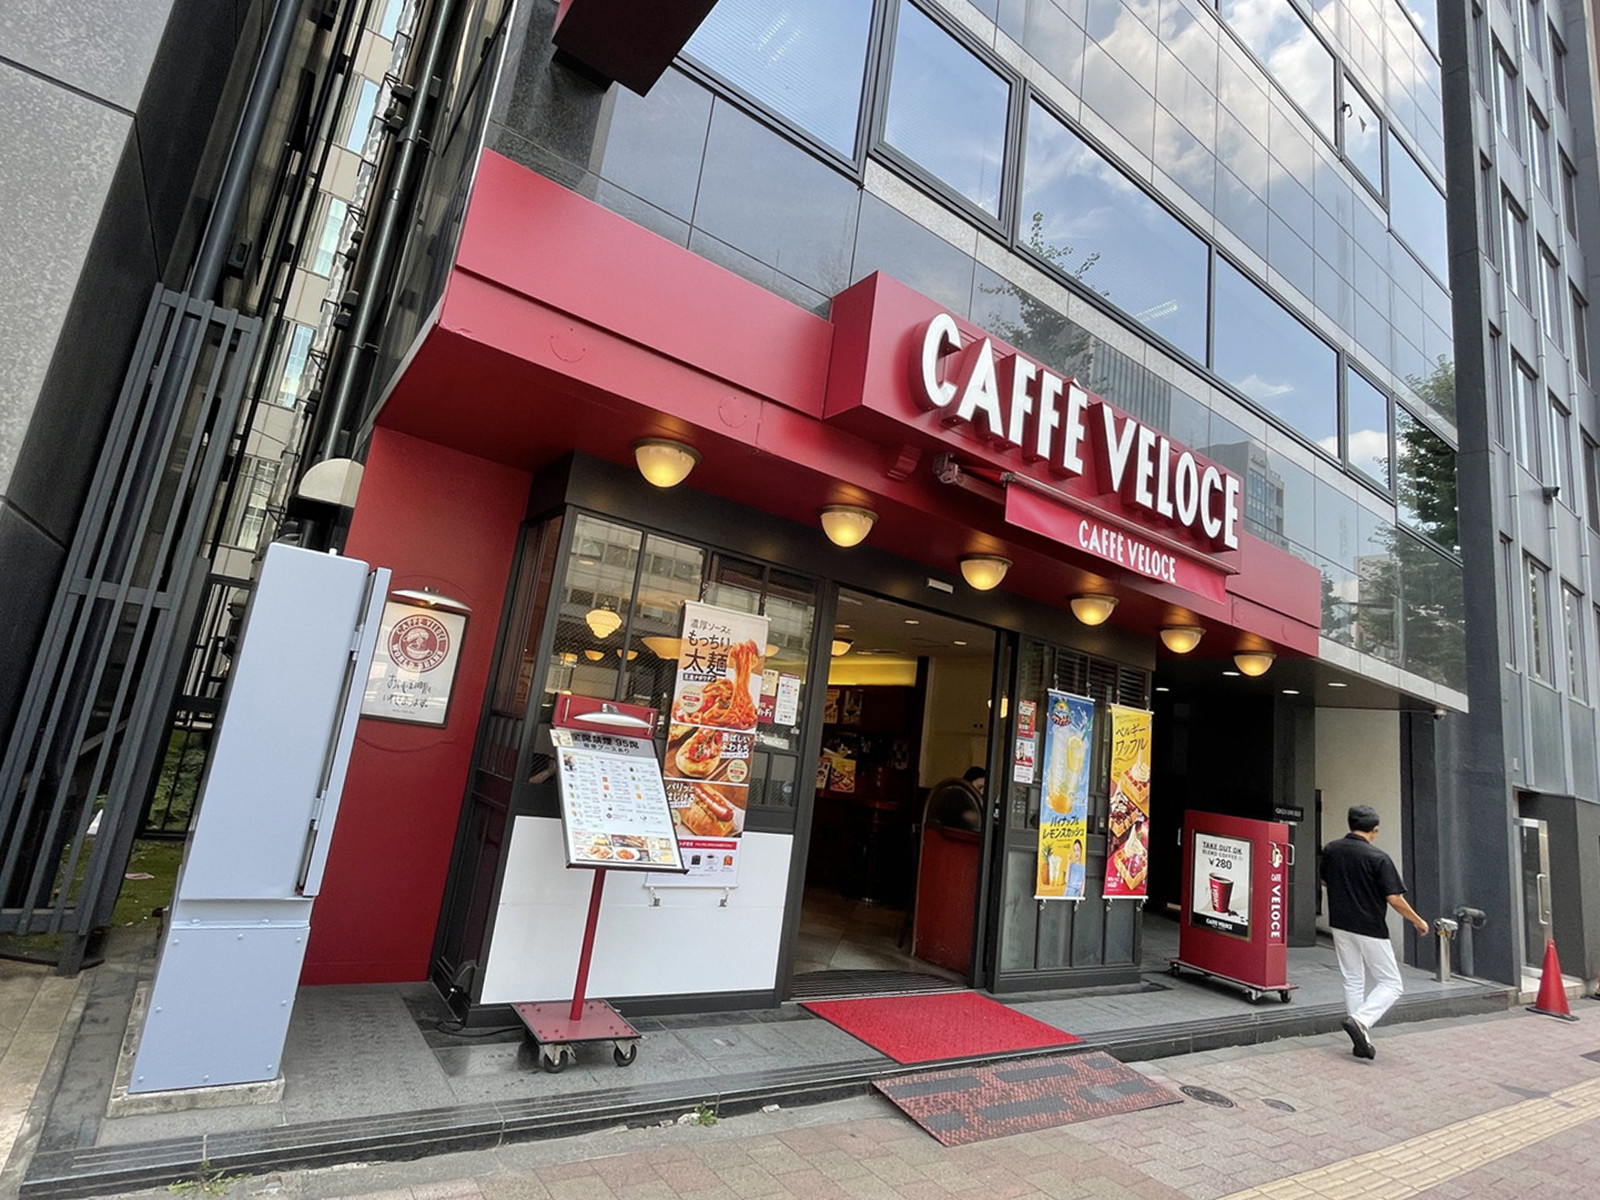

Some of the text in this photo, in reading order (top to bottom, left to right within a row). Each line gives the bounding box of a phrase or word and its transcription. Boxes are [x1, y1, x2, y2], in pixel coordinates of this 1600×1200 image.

[921, 312, 1240, 551] CAFFÈ VELOCE
[1078, 520, 1176, 583] CAFFÈ VELOCE
[690, 618, 731, 634] 濃厚ソースと
[688, 629, 730, 652] もっちり
[683, 648, 728, 677] 太麺
[1116, 723, 1146, 738] ベルギー
[1116, 738, 1149, 757] ワッフル
[1050, 815, 1080, 828] パイナップル
[1043, 827, 1084, 840] レモンスカッシュ
[1202, 849, 1238, 860] BLEND COFFEE
[1203, 842, 1218, 850] TAKE
[1233, 847, 1242, 855] OK
[1208, 857, 1232, 870] ¥280
[1270, 885, 1282, 938] VELOCE
